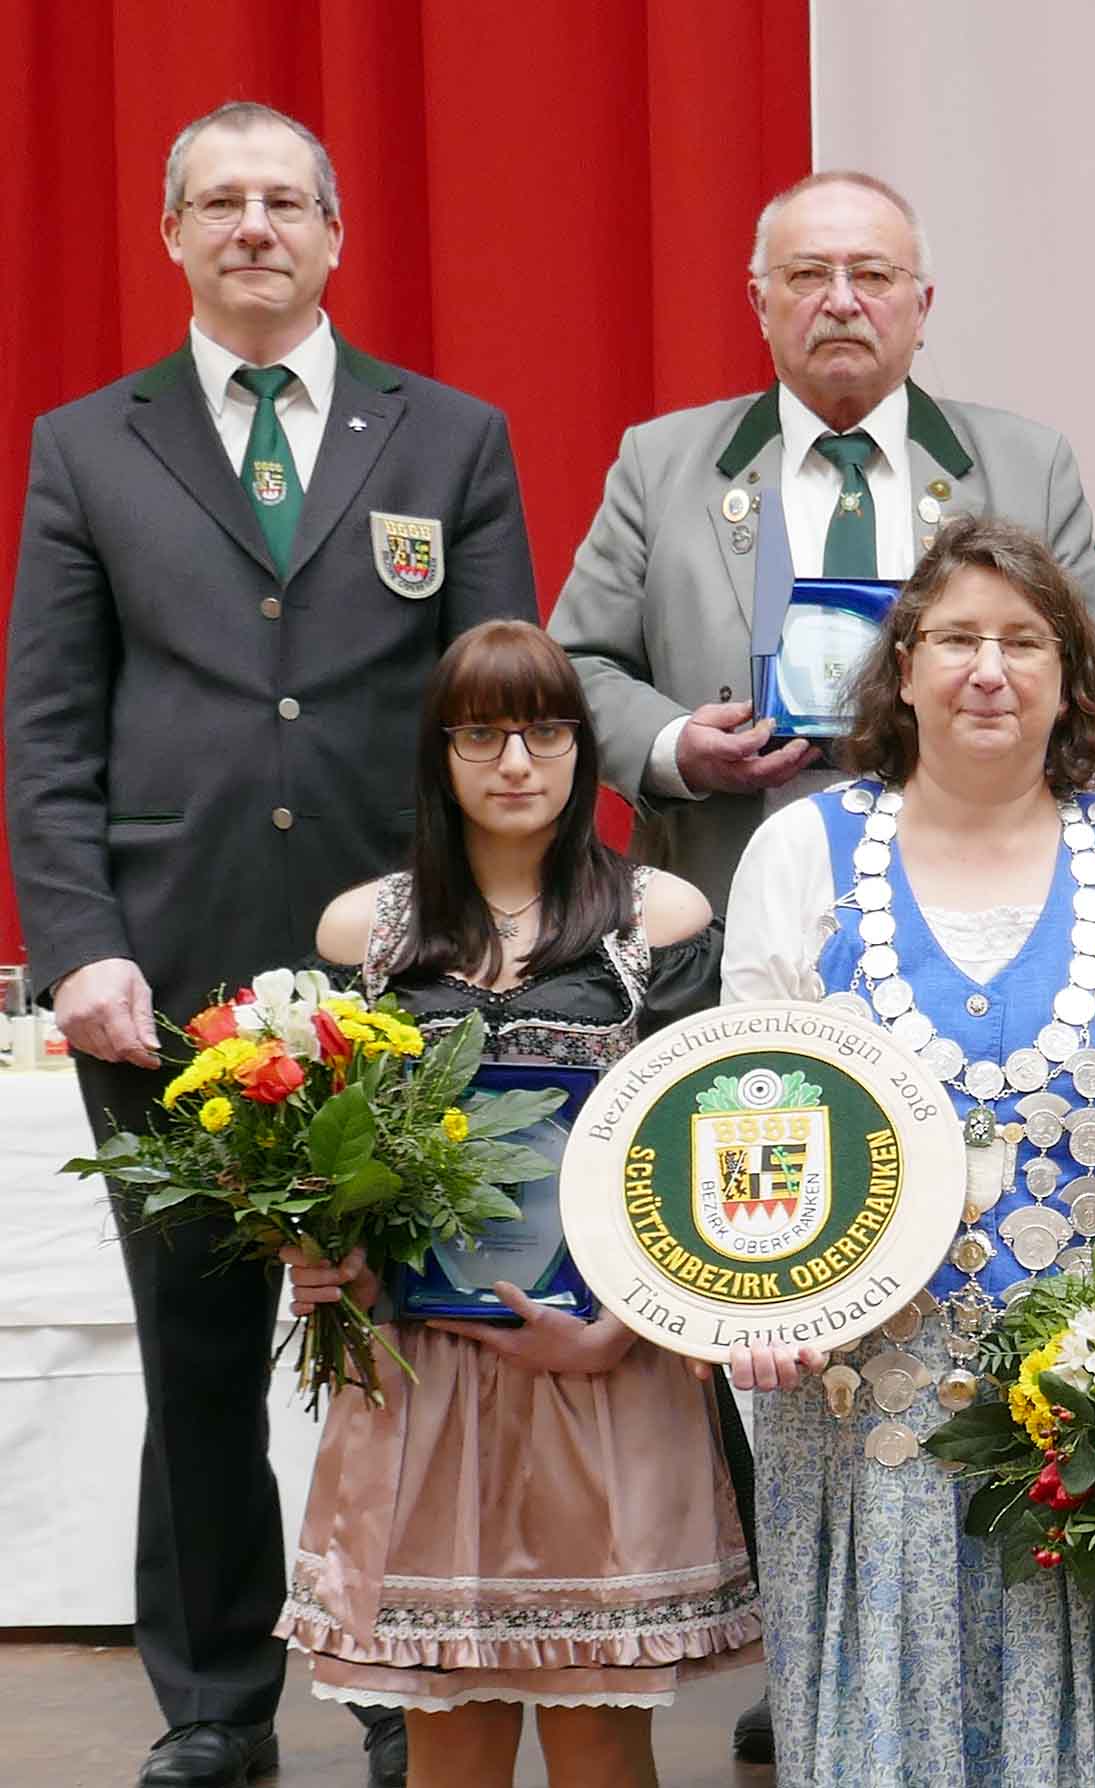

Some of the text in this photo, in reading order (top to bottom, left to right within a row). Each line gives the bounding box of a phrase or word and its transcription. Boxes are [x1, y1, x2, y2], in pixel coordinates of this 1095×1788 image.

[890, 1071, 937, 1121] 2018
[626, 1128, 899, 1297] SCHÜTZENBEZIRK OBERFRANKEN
[701, 1172, 820, 1254] BEZIRK OBERFRANKEN
[622, 1278, 688, 1335] Tina
